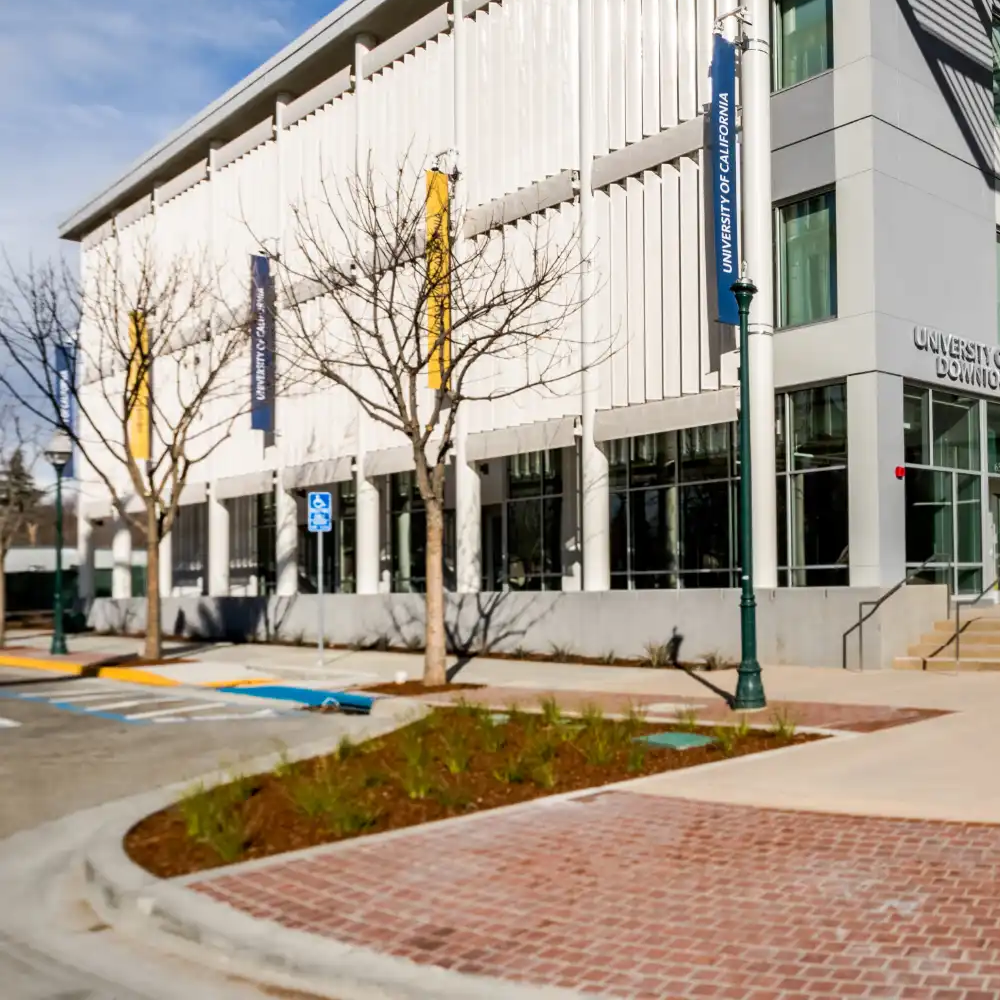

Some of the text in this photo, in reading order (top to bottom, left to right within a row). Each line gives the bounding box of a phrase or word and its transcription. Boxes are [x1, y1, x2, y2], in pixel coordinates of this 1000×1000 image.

[718, 92, 732, 274] UNIVERSITY OF CALIFORNIA
[913, 326, 994, 367] UNIVERSITY
